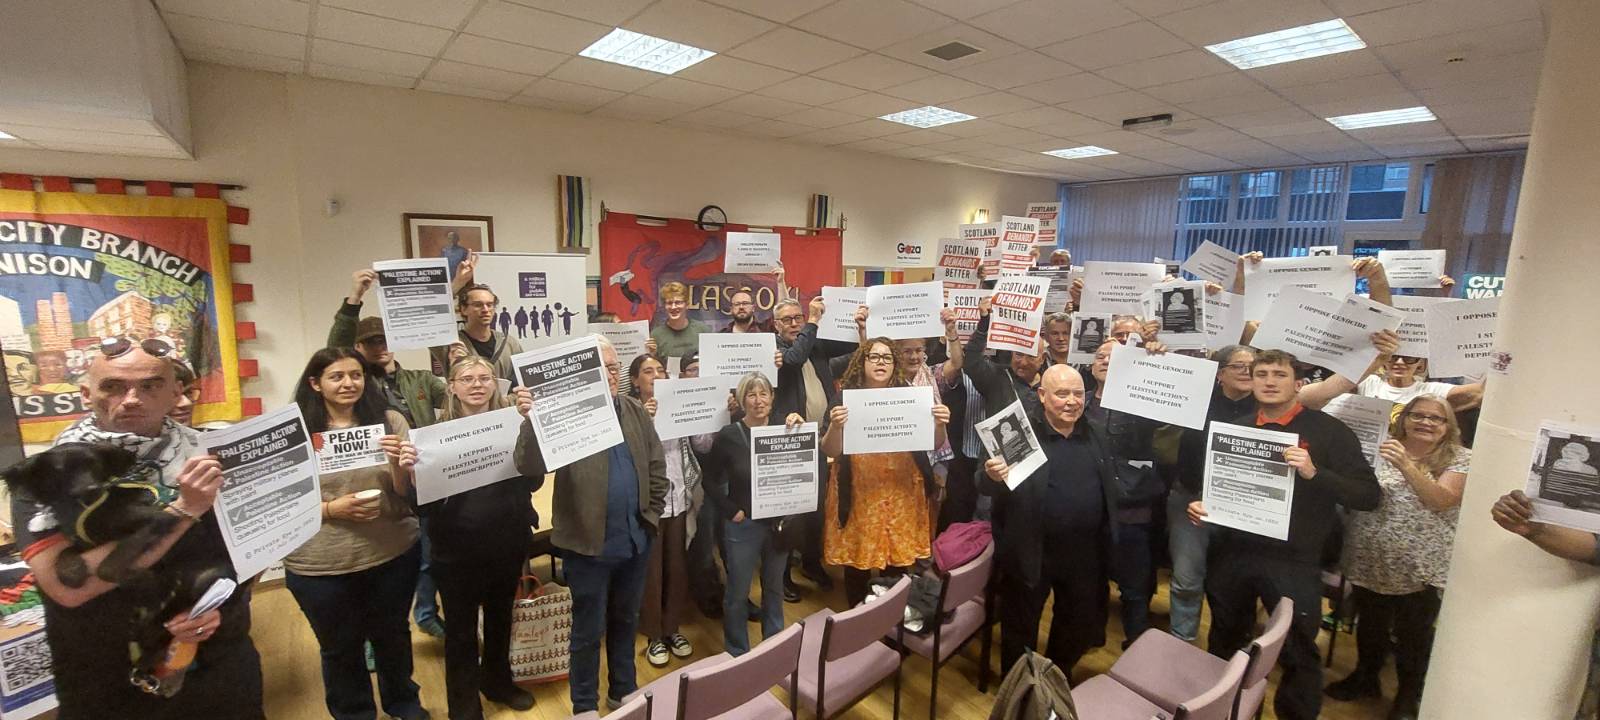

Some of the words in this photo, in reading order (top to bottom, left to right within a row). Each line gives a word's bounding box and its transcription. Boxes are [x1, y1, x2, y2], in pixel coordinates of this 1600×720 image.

[964, 228, 997, 238] SCOTLAND
[1006, 221, 1035, 232] SCOTLAND
[0, 220, 66, 246] CITY
[81, 227, 200, 284] BRANCH
[943, 244, 979, 257] SCOTLAND
[1007, 242, 1028, 252] BETTER
[943, 257, 978, 269] DEMANDS
[945, 267, 971, 279] BETTER
[998, 282, 1040, 296] SCOTLAND
[996, 293, 1037, 310] DEMANDS
[998, 307, 1028, 322] BETTER
[1304, 305, 1330, 318] OPPOSE
[1331, 315, 1368, 330] GENOCIDE
[1463, 311, 1498, 320] OPPOSE
[958, 321, 977, 331] BETT
[525, 359, 567, 376] 'PALESTINE
[567, 350, 595, 364] ACTION'
[1138, 361, 1161, 370] OPPOSE
[1162, 364, 1194, 375] GENOCIDE
[543, 363, 582, 380] EXPLAINED
[1126, 384, 1158, 395] PALESTINE
[1147, 379, 1176, 390] SUPPORT
[12, 395, 44, 416] IS
[329, 428, 372, 444] PEACE
[445, 431, 472, 443] OPPOSE
[472, 423, 504, 436] GENOCIDE
[217, 434, 270, 459] 'PALESTINE
[271, 422, 299, 441] ACTION'
[333, 439, 369, 454] NOW!
[770, 442, 801, 451] EXPLAINED
[1217, 435, 1257, 449] 'PALESTINE
[240, 438, 289, 462] EXPLAINED
[463, 444, 493, 458] SUPPORT
[1231, 445, 1272, 458] EXPLAINED
[442, 459, 478, 473] PALESTINE
[447, 459, 505, 480] DEPROSCRIPTION
